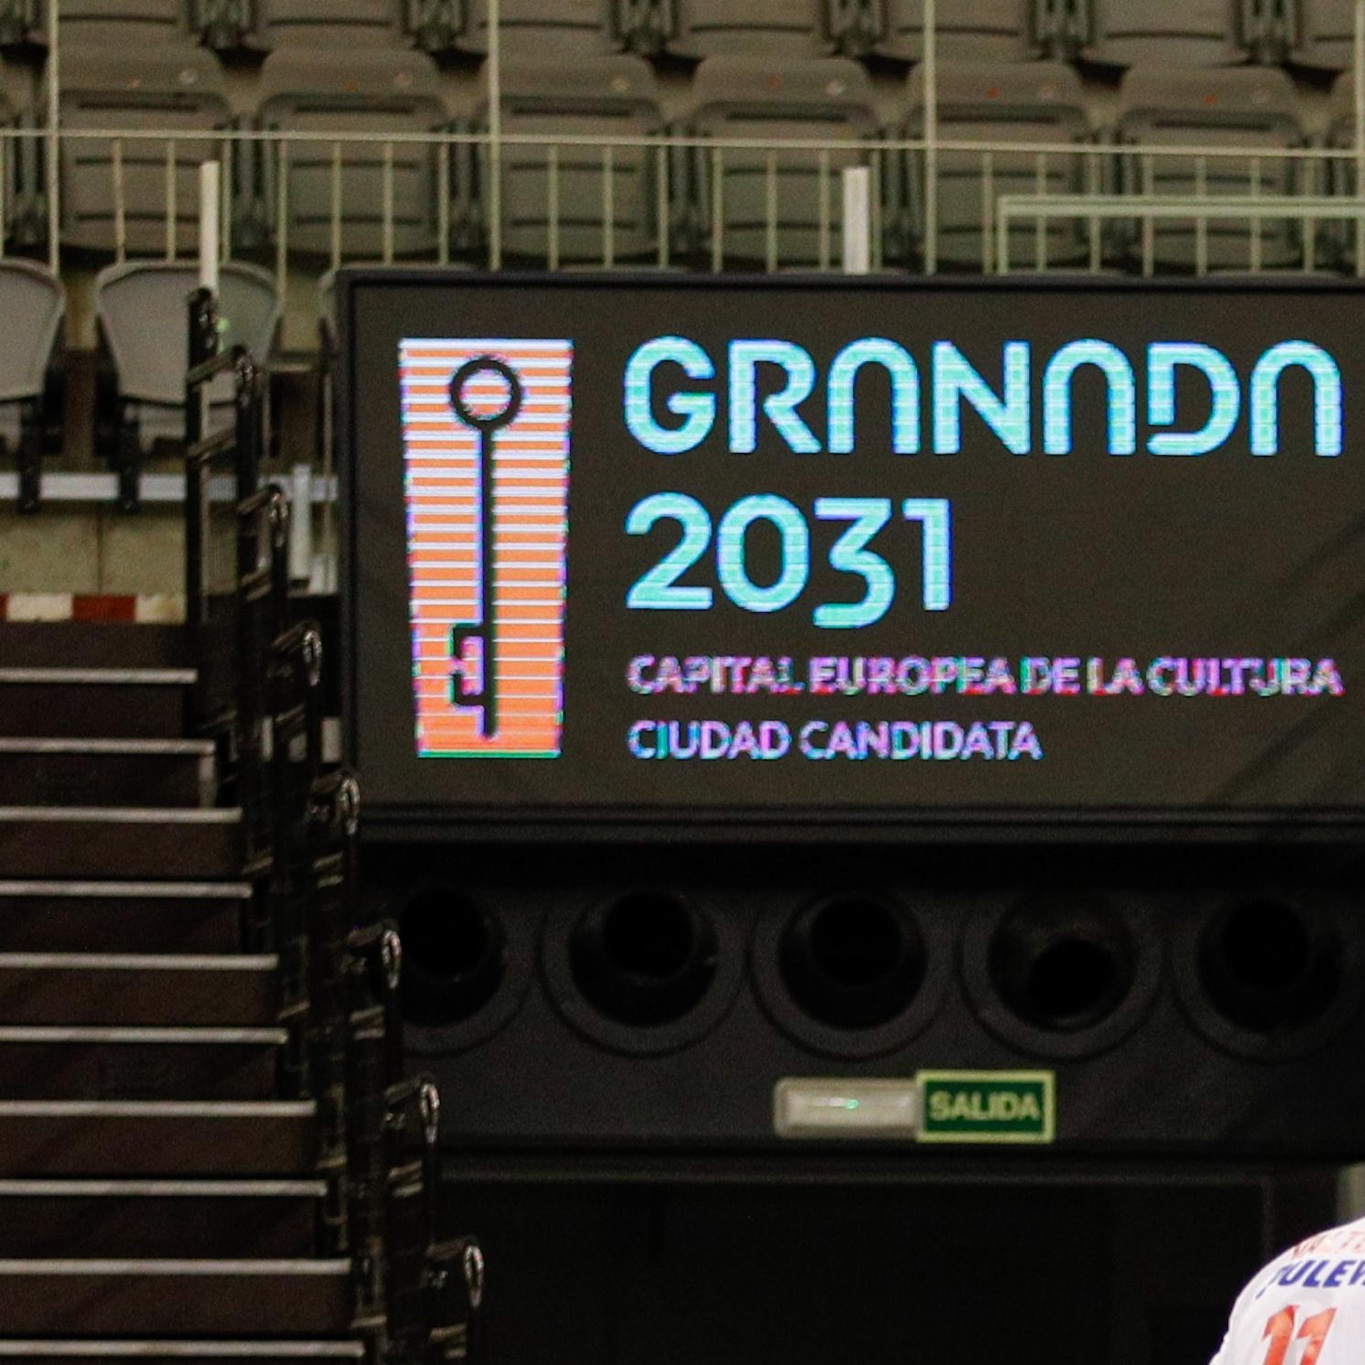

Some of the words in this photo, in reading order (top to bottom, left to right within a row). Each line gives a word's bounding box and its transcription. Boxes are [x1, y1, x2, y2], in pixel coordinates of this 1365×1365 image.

[624, 336, 1343, 455] GRANADA
[625, 492, 951, 628] 2031
[627, 655, 803, 696] CAPITAL
[809, 655, 1015, 696] EUROPEA
[1022, 656, 1080, 696] DE
[1087, 657, 1142, 697] LA
[1144, 657, 1344, 697] CULTURA
[628, 720, 790, 761] CIUDAD
[800, 720, 1042, 761] CANDIDATA
[930, 1091, 1039, 1121] SALIDA
